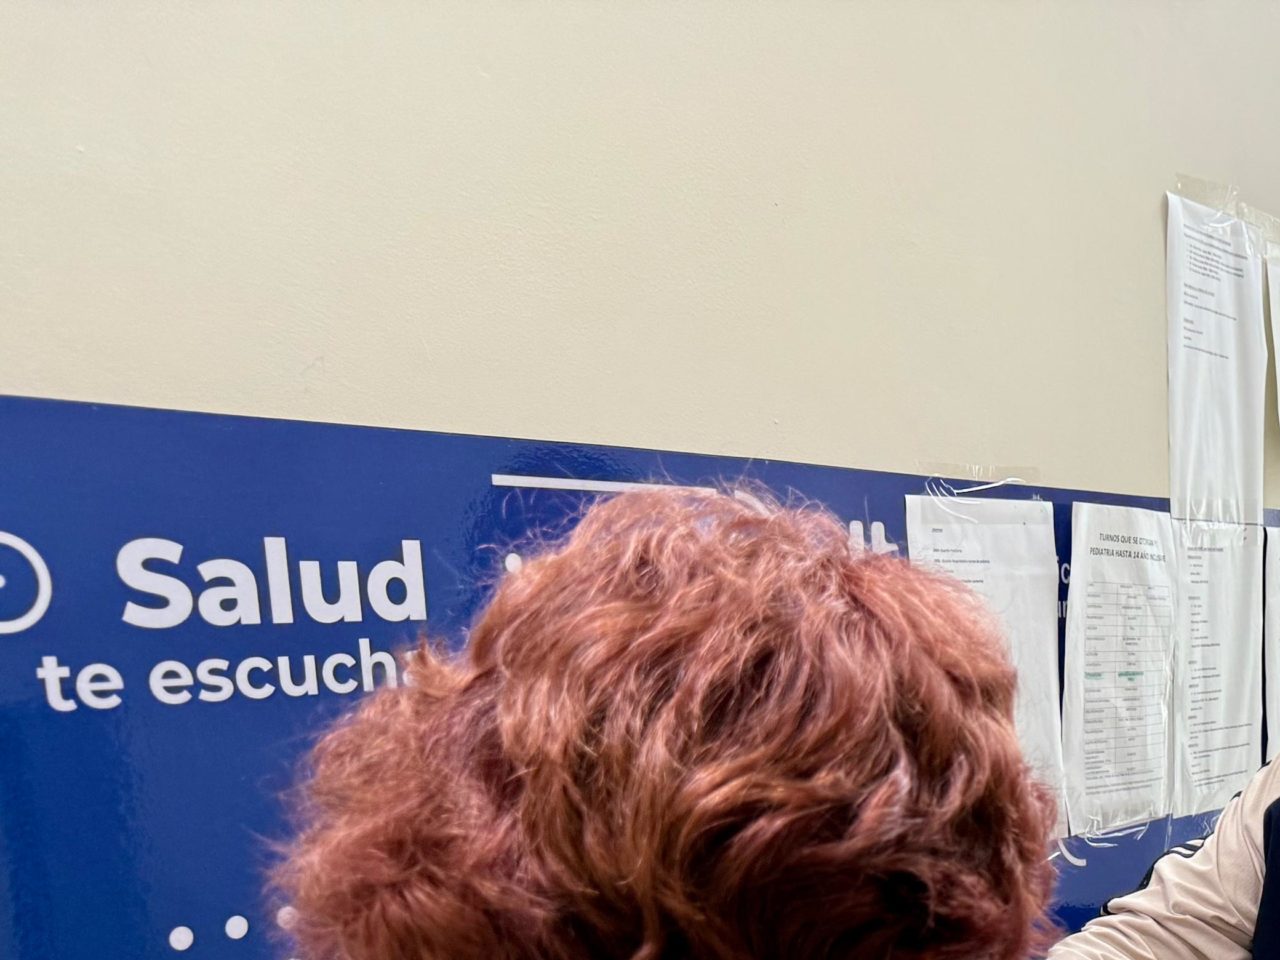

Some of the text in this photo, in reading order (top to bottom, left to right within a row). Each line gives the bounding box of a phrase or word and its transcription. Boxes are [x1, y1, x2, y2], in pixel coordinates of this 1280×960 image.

[1089, 547, 1115, 558] PEDIATRIA
[1115, 549, 1132, 559] HASTA
[1133, 551, 1140, 560] 14
[1099, 533, 1120, 543] TURNOS
[1121, 535, 1132, 545] QUE
[1132, 536, 1139, 545] SE
[116, 536, 428, 630] Salud
[36, 655, 124, 713] te
